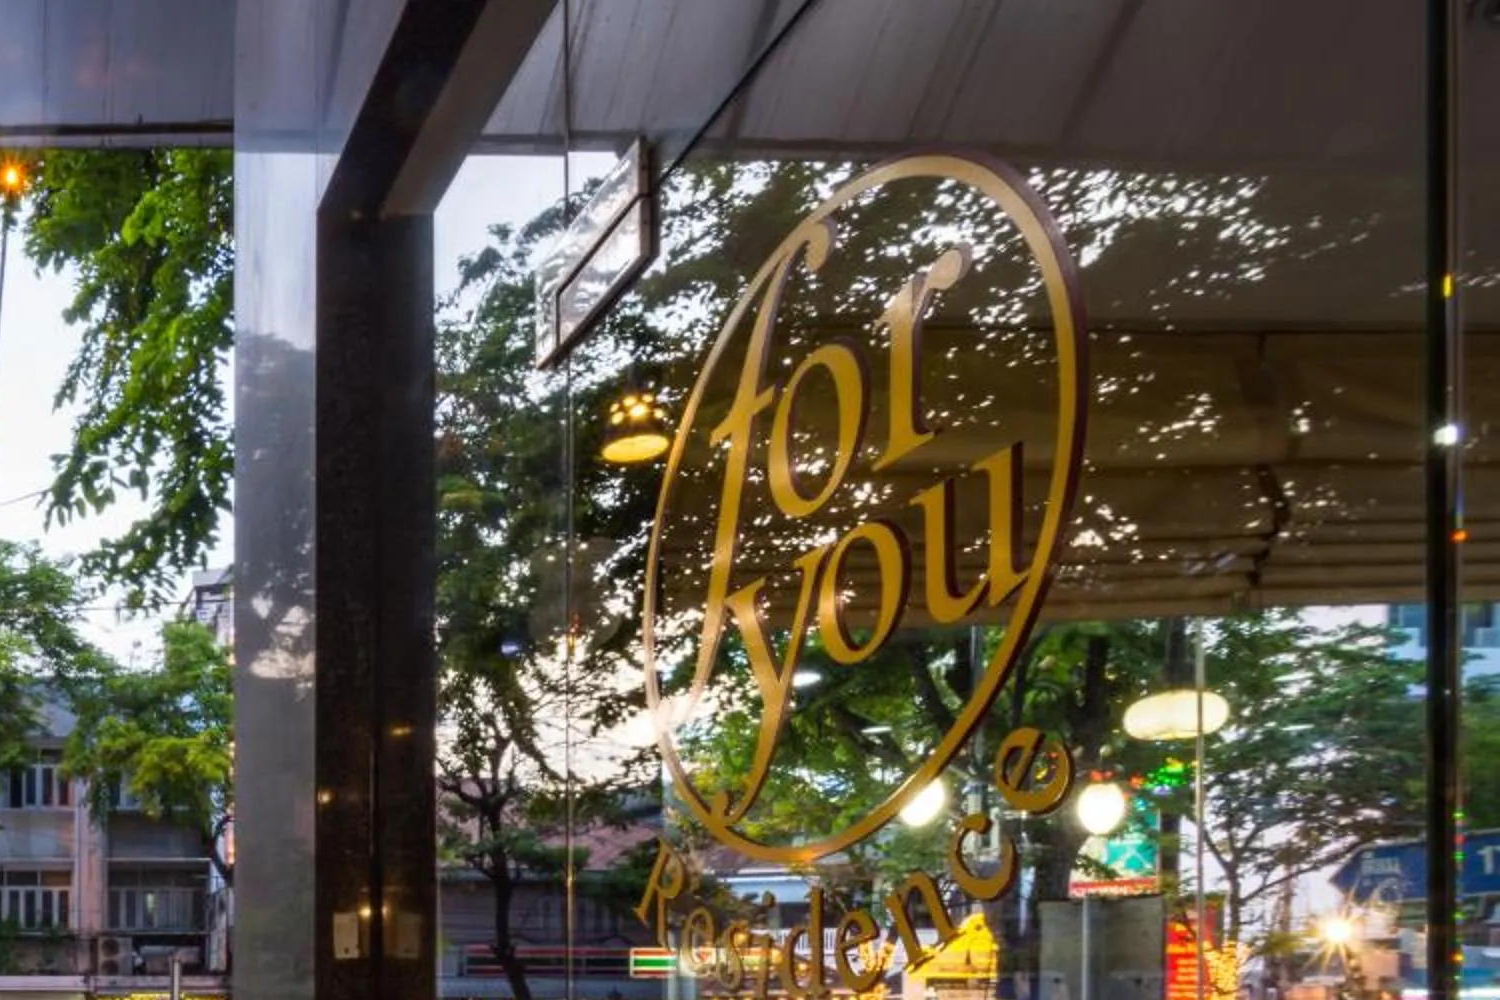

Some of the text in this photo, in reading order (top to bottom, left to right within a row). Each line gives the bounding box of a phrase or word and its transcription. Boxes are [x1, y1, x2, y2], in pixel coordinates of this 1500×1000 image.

[657, 215, 974, 733] for
[711, 440, 1033, 826] you
[633, 727, 1076, 1000] Residence
